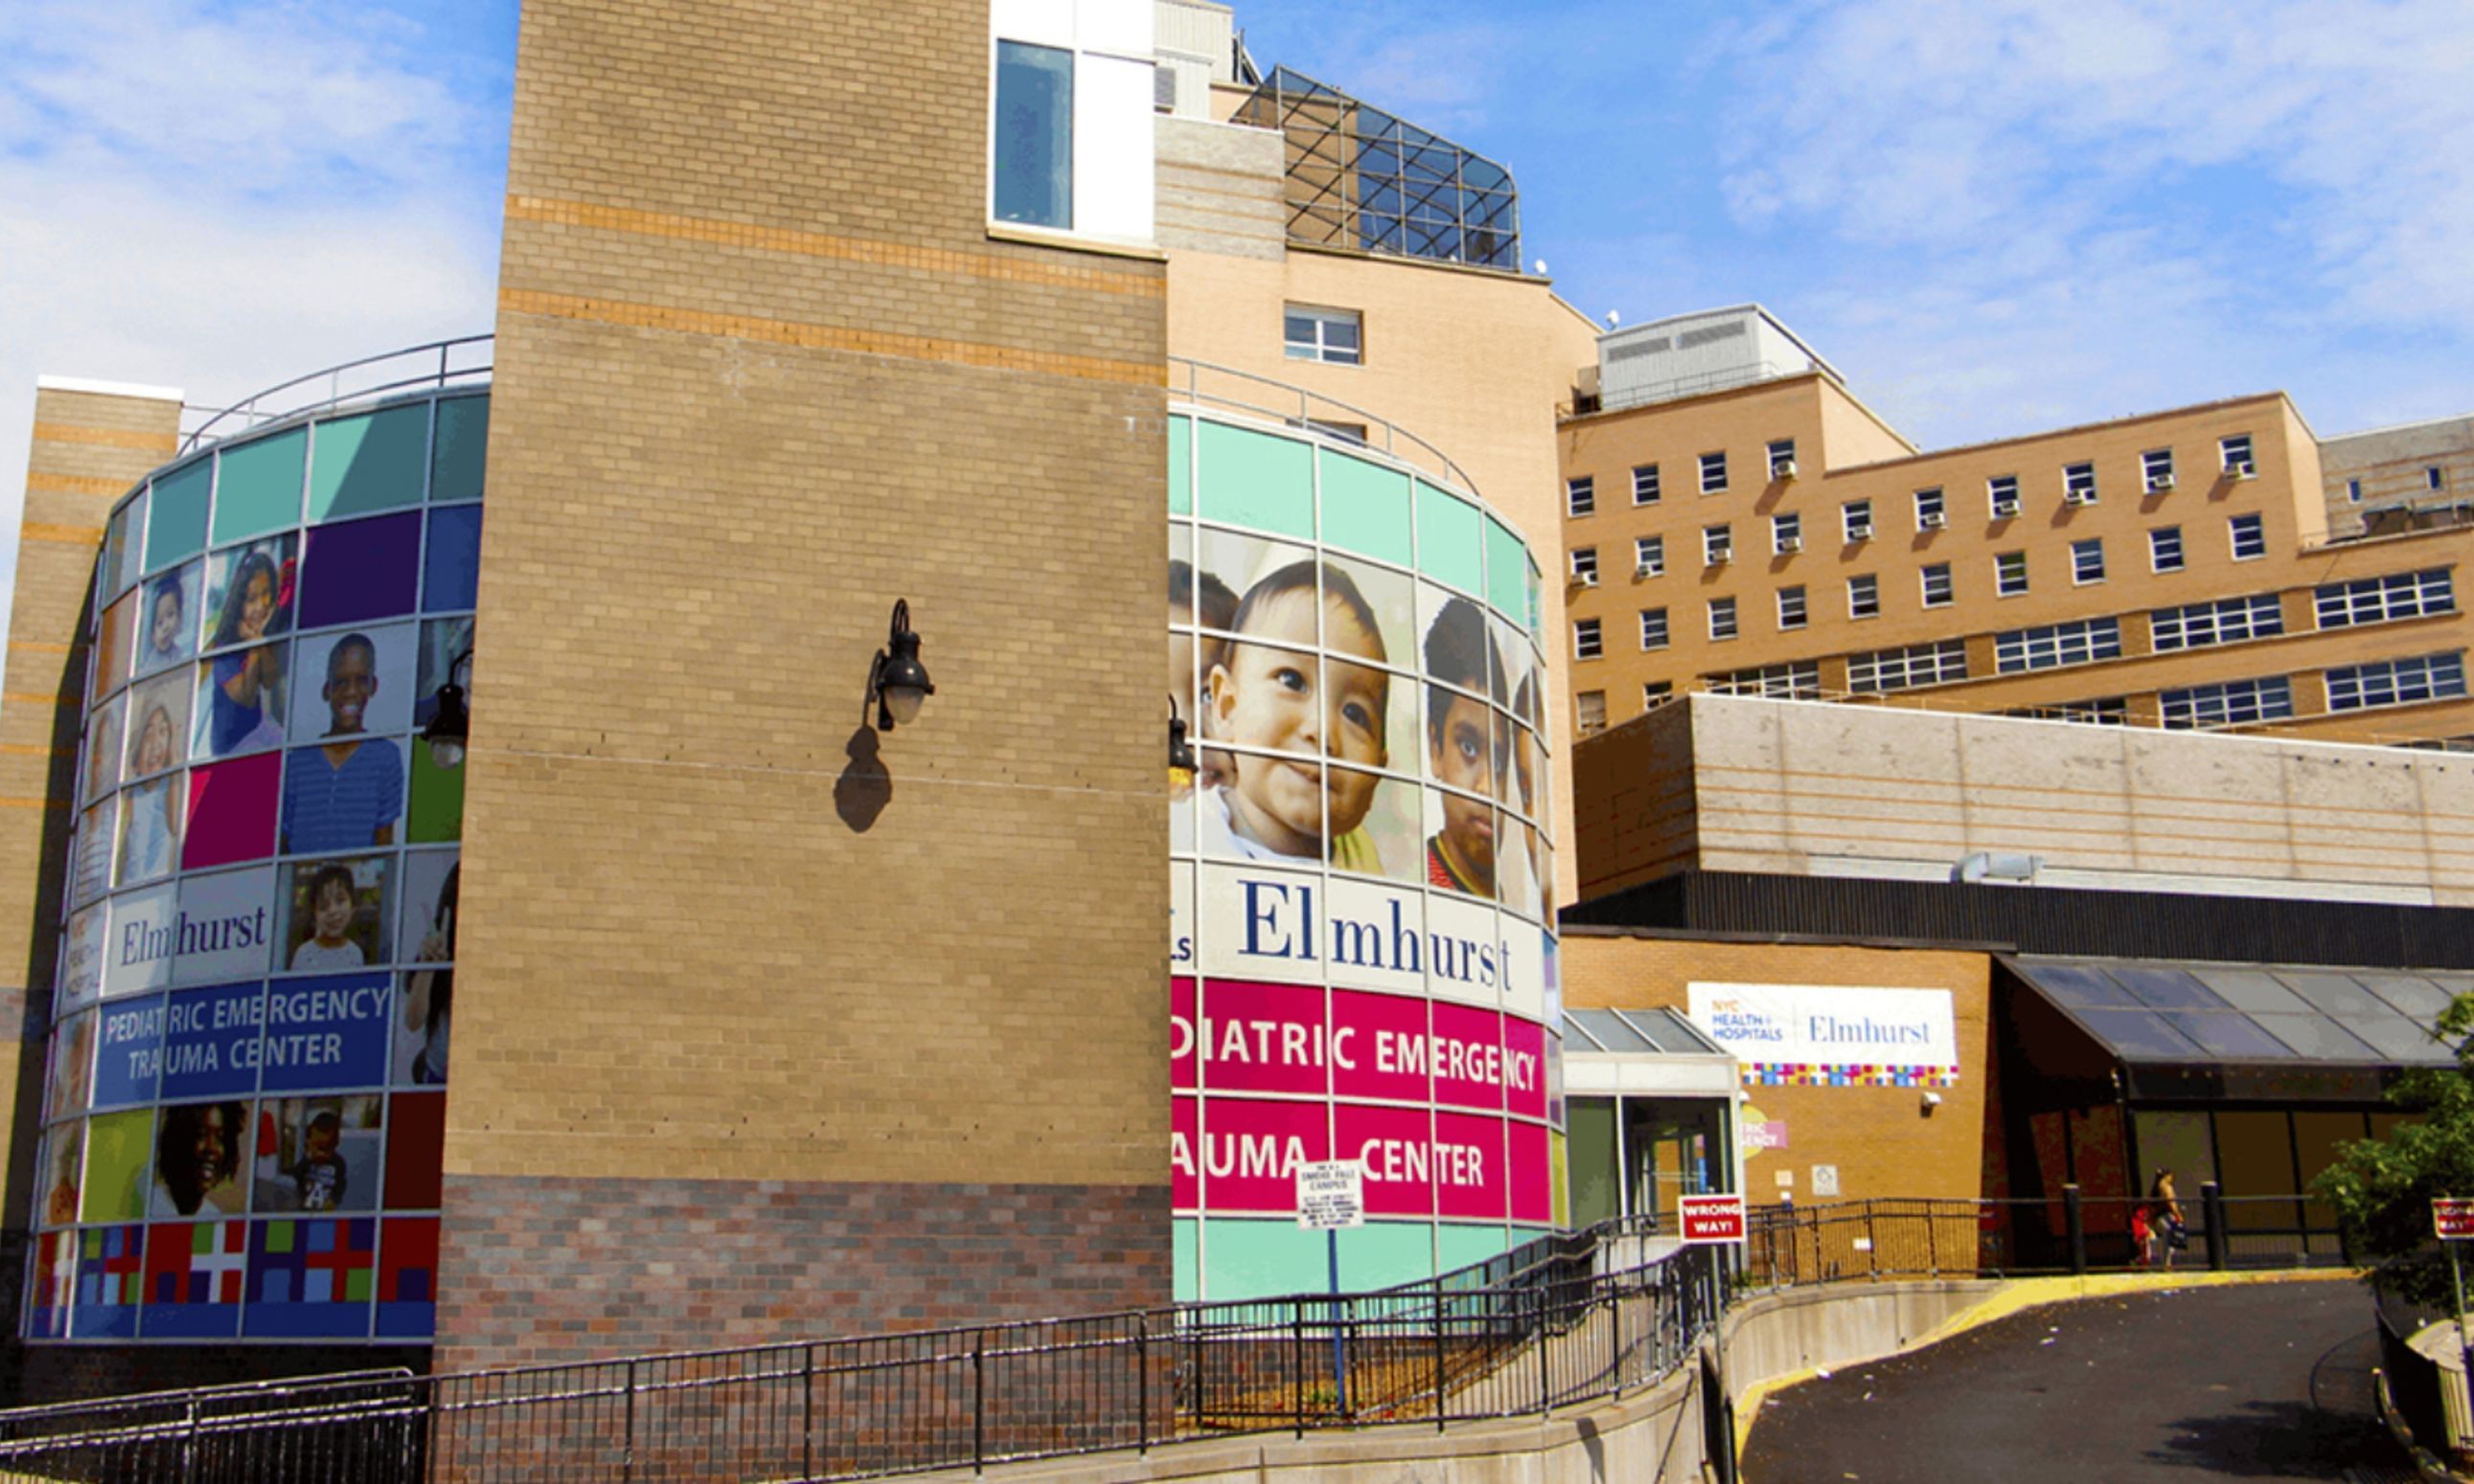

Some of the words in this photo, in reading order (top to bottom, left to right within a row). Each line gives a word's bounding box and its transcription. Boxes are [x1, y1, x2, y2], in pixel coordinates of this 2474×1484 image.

[121, 907, 265, 966] Elmhurst
[1237, 879, 1511, 991] Elmhurst
[105, 1001, 205, 1044] PEDIATRIC
[212, 986, 390, 1029] EMERGENCY
[1712, 999, 1738, 1013] NYC
[1809, 1016, 1930, 1043] Elmhurst
[129, 1042, 218, 1080] TRAUMA
[229, 1033, 342, 1069] CENTER
[1713, 1027, 1782, 1041] HOSPITALS
[1376, 1030, 1535, 1091] EMERGENCY
[1361, 1138, 1484, 1187] CENTER
[1684, 1204, 1740, 1216] WRONG
[1694, 1221, 1732, 1233] WAY!
